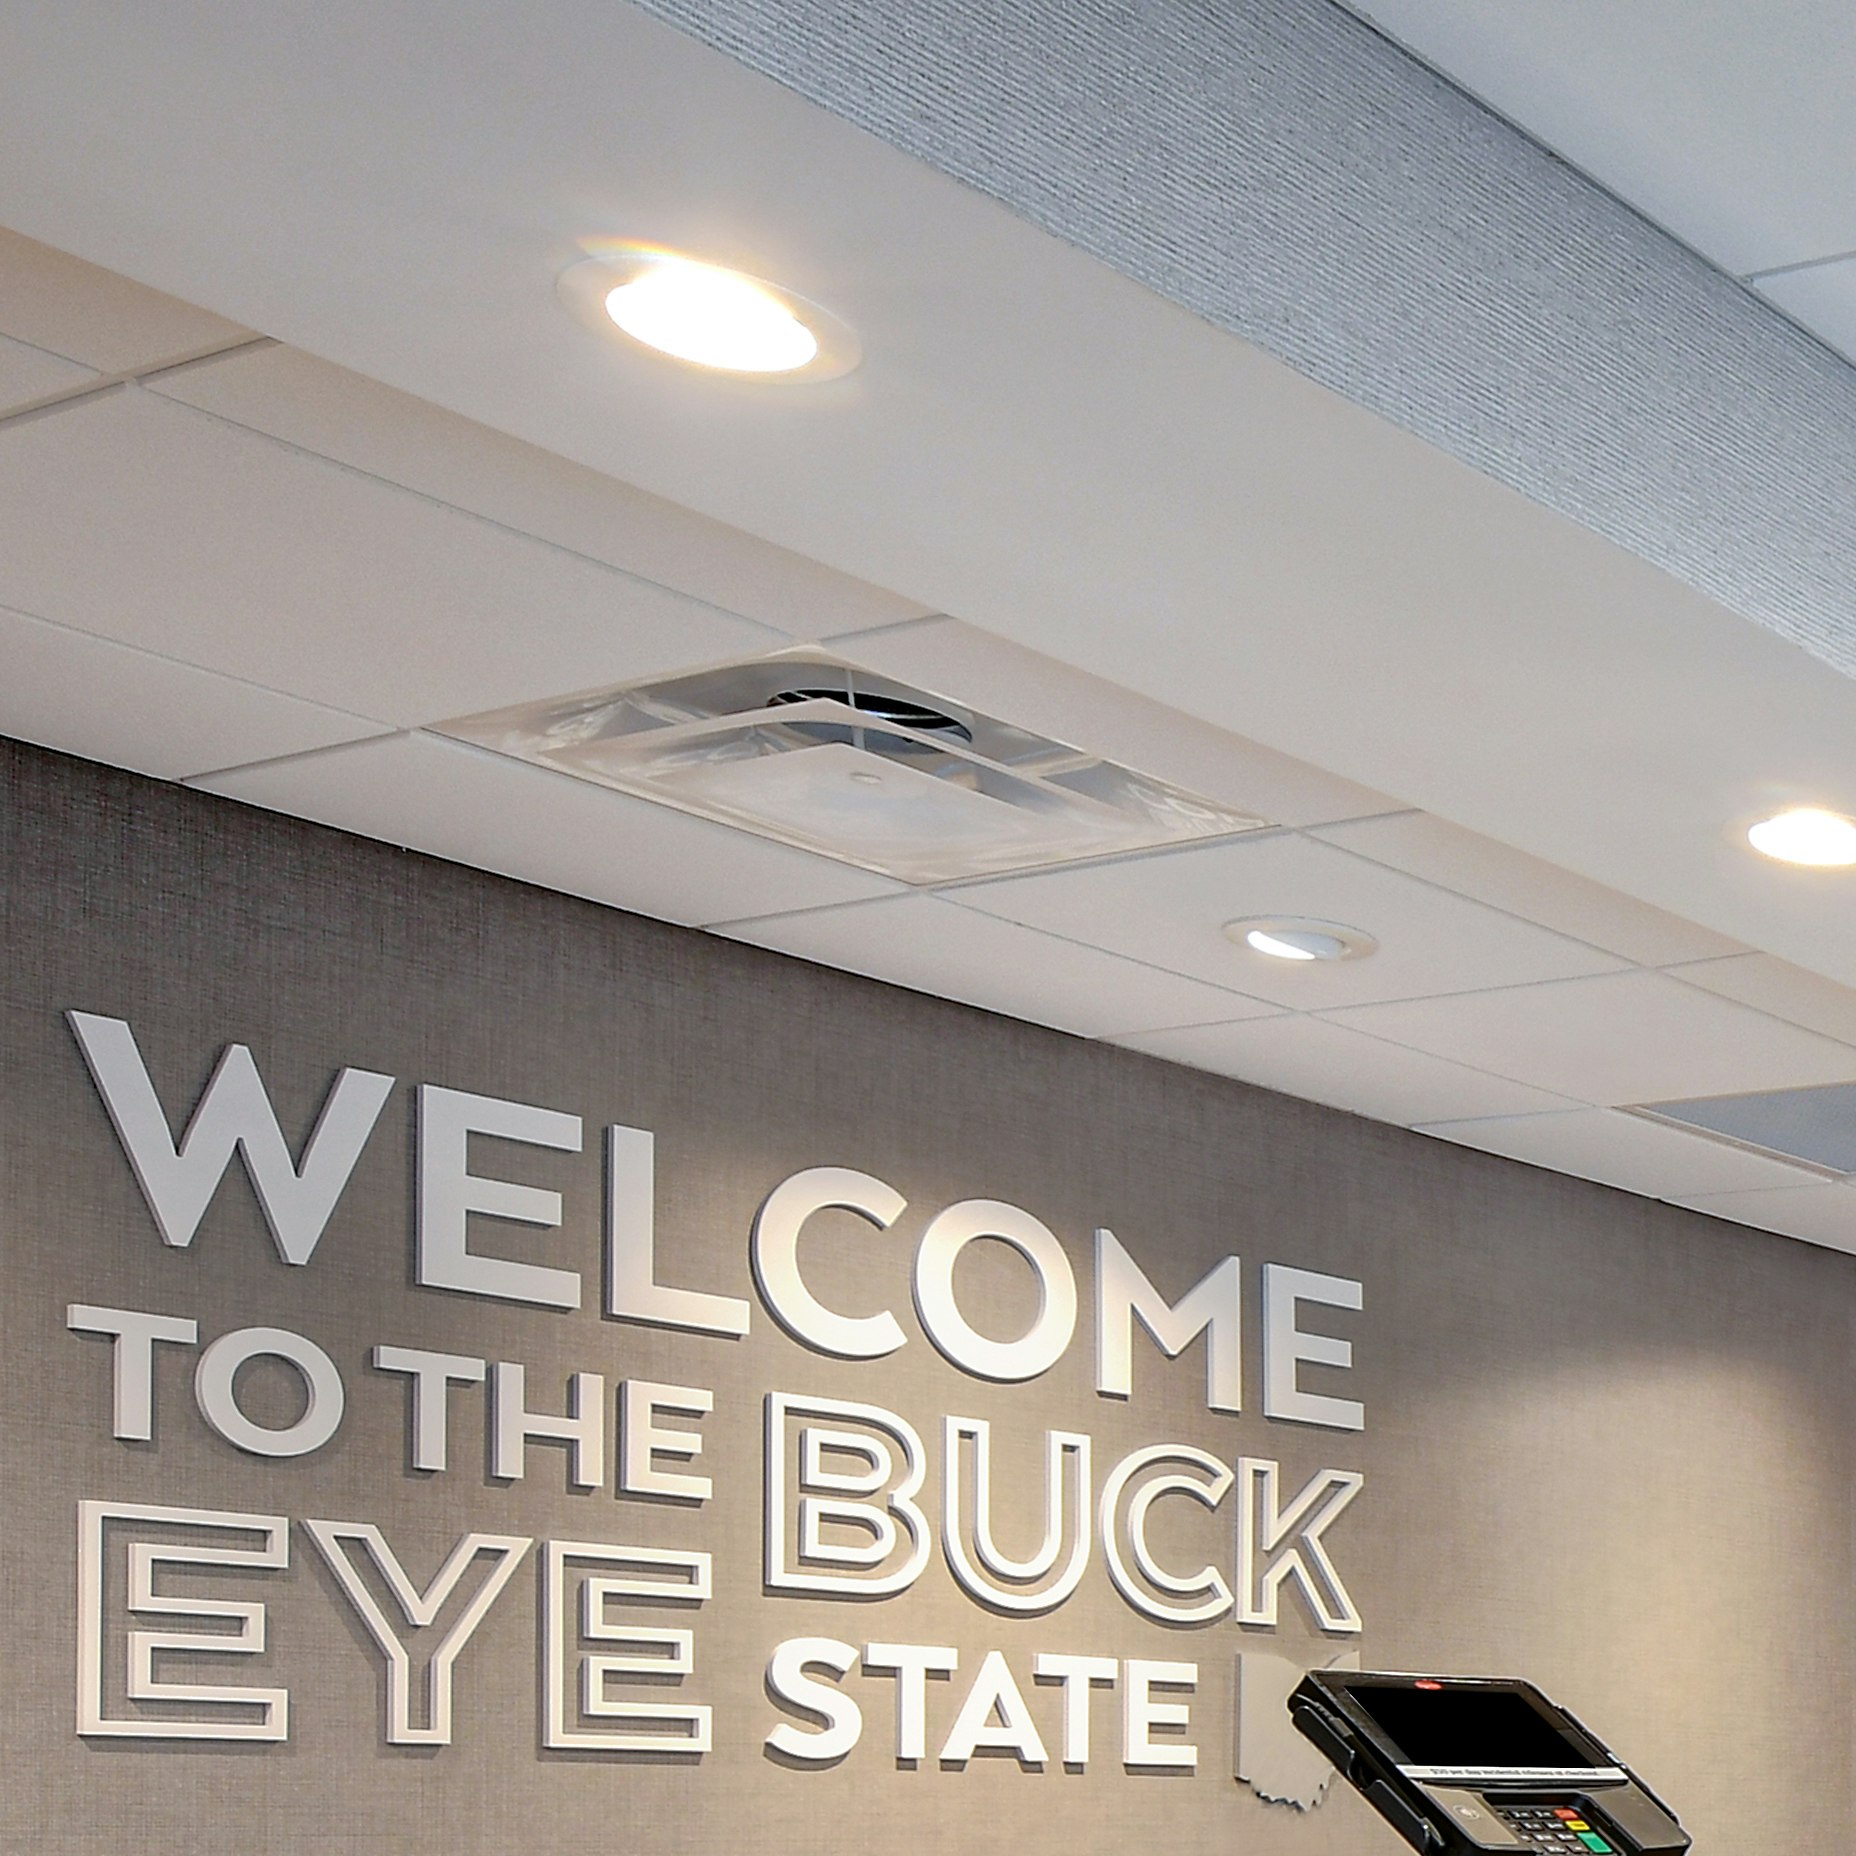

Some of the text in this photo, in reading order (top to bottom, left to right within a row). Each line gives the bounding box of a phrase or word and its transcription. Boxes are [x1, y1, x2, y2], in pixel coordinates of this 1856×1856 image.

[64, 1009, 1365, 1431] WELCOME
[66, 1303, 1364, 1633] TO THE BUCK
[76, 1500, 1199, 1766] EYE STATE
